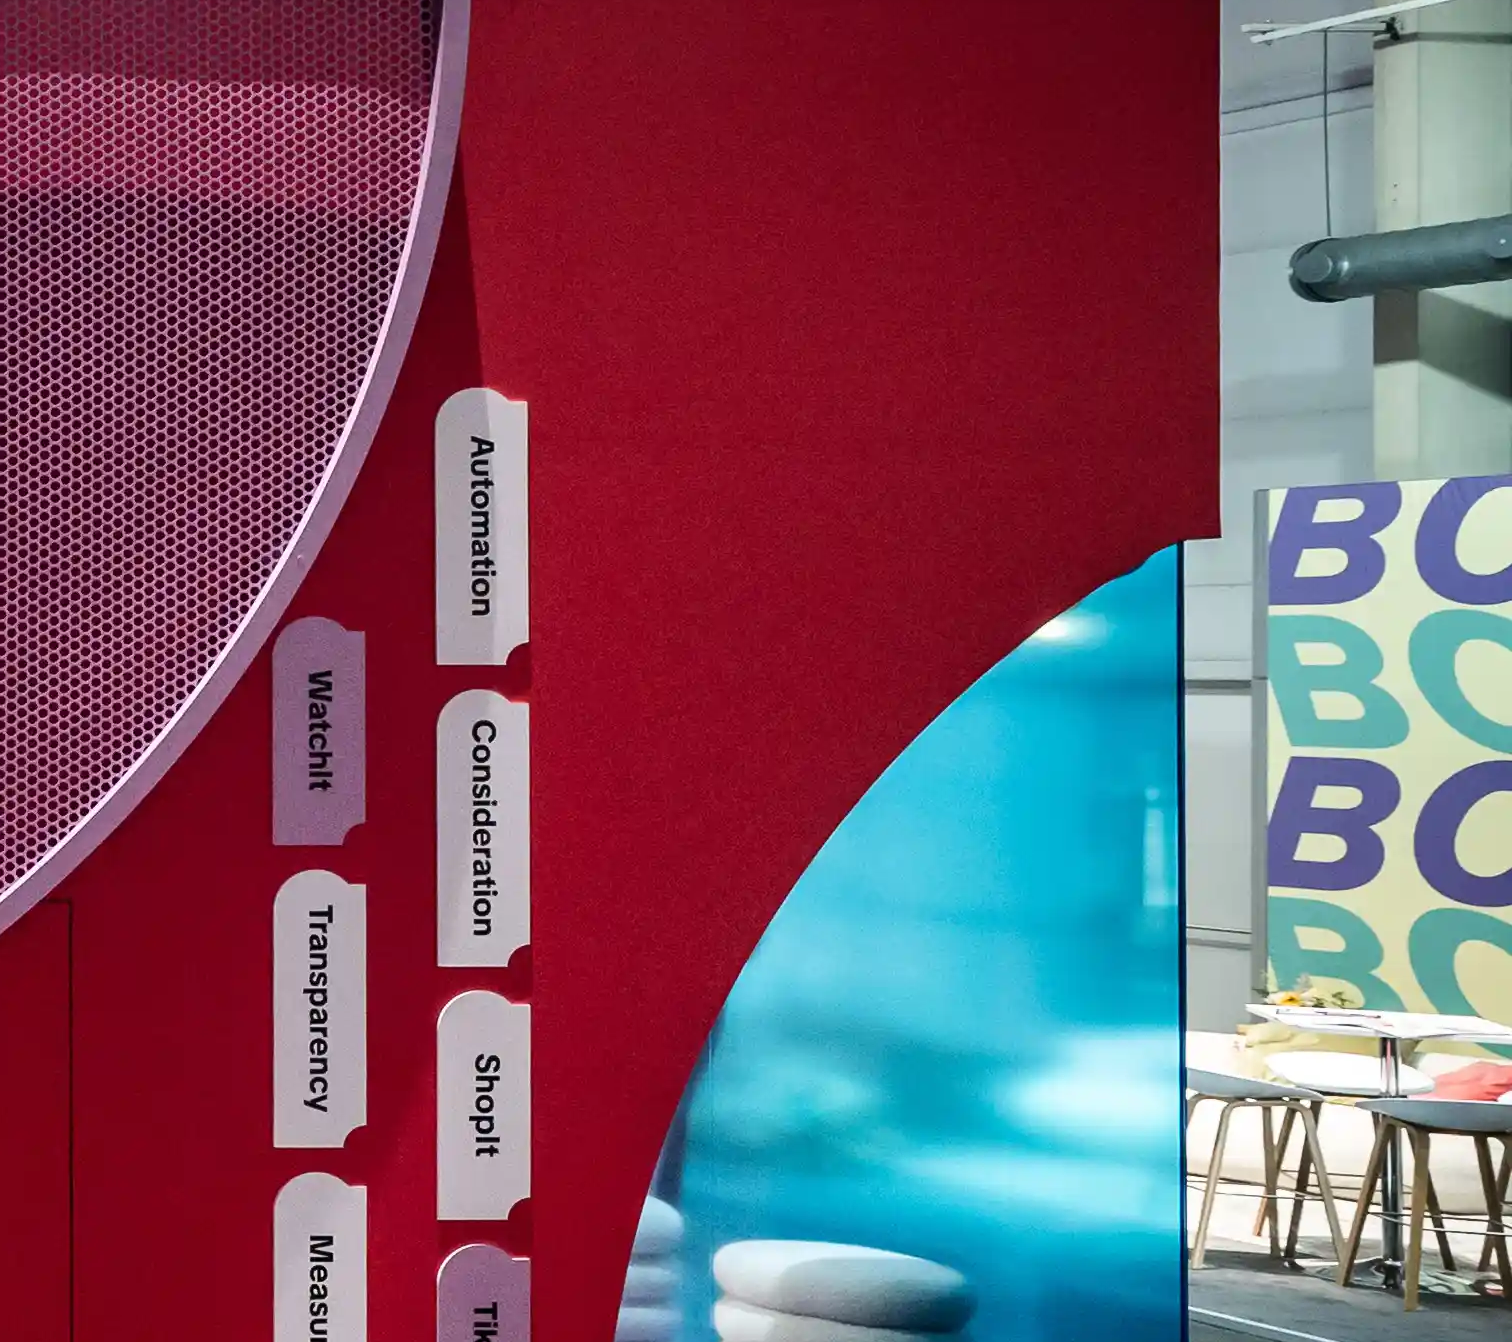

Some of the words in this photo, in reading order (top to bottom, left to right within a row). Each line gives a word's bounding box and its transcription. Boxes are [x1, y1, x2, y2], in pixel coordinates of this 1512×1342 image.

[470, 436, 497, 616] Automation
[308, 670, 333, 792] WatchIt
[471, 719, 498, 936] Consideration
[302, 904, 334, 1113] Transparency
[468, 1053, 500, 1158] ShopIt
